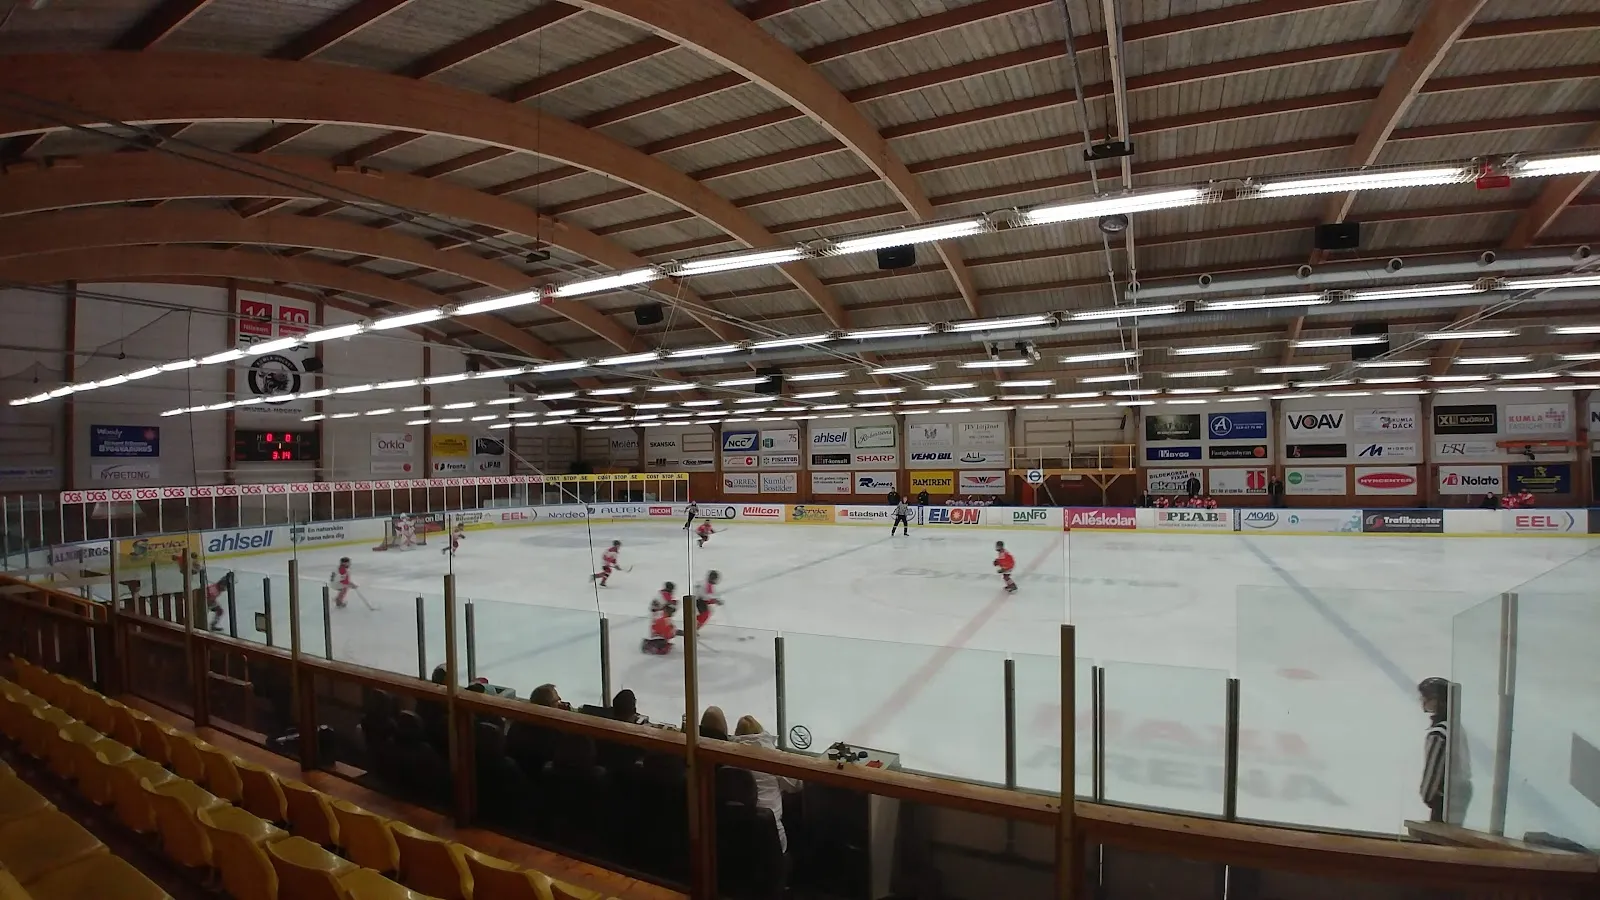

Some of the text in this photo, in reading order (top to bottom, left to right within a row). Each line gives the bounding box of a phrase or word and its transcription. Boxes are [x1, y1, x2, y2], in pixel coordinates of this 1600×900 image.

[1288, 413, 1344, 430] VOAV
[1508, 415, 1543, 423] KUMLA
[813, 431, 848, 443] ahlsell
[378, 440, 405, 450] Orkla
[856, 454, 895, 462] SHARP
[911, 452, 953, 460] VEHO BIL
[101, 471, 150, 479] NYBETONG
[1461, 475, 1499, 485] Nolato
[763, 477, 786, 485] Kumla
[912, 478, 952, 486] RAMIRENT
[548, 510, 586, 518] Nordea
[743, 506, 780, 515] Millcon
[849, 509, 888, 517] stadsnät
[1013, 509, 1047, 521] DANFO
[501, 511, 529, 521] EEL
[928, 508, 980, 524] ELON
[1166, 512, 1219, 522] PEAB
[1245, 511, 1276, 521] MOAB
[1383, 516, 1441, 524] Trafikcenter
[1515, 515, 1559, 527] EEL
[207, 530, 274, 552] ahlsell
